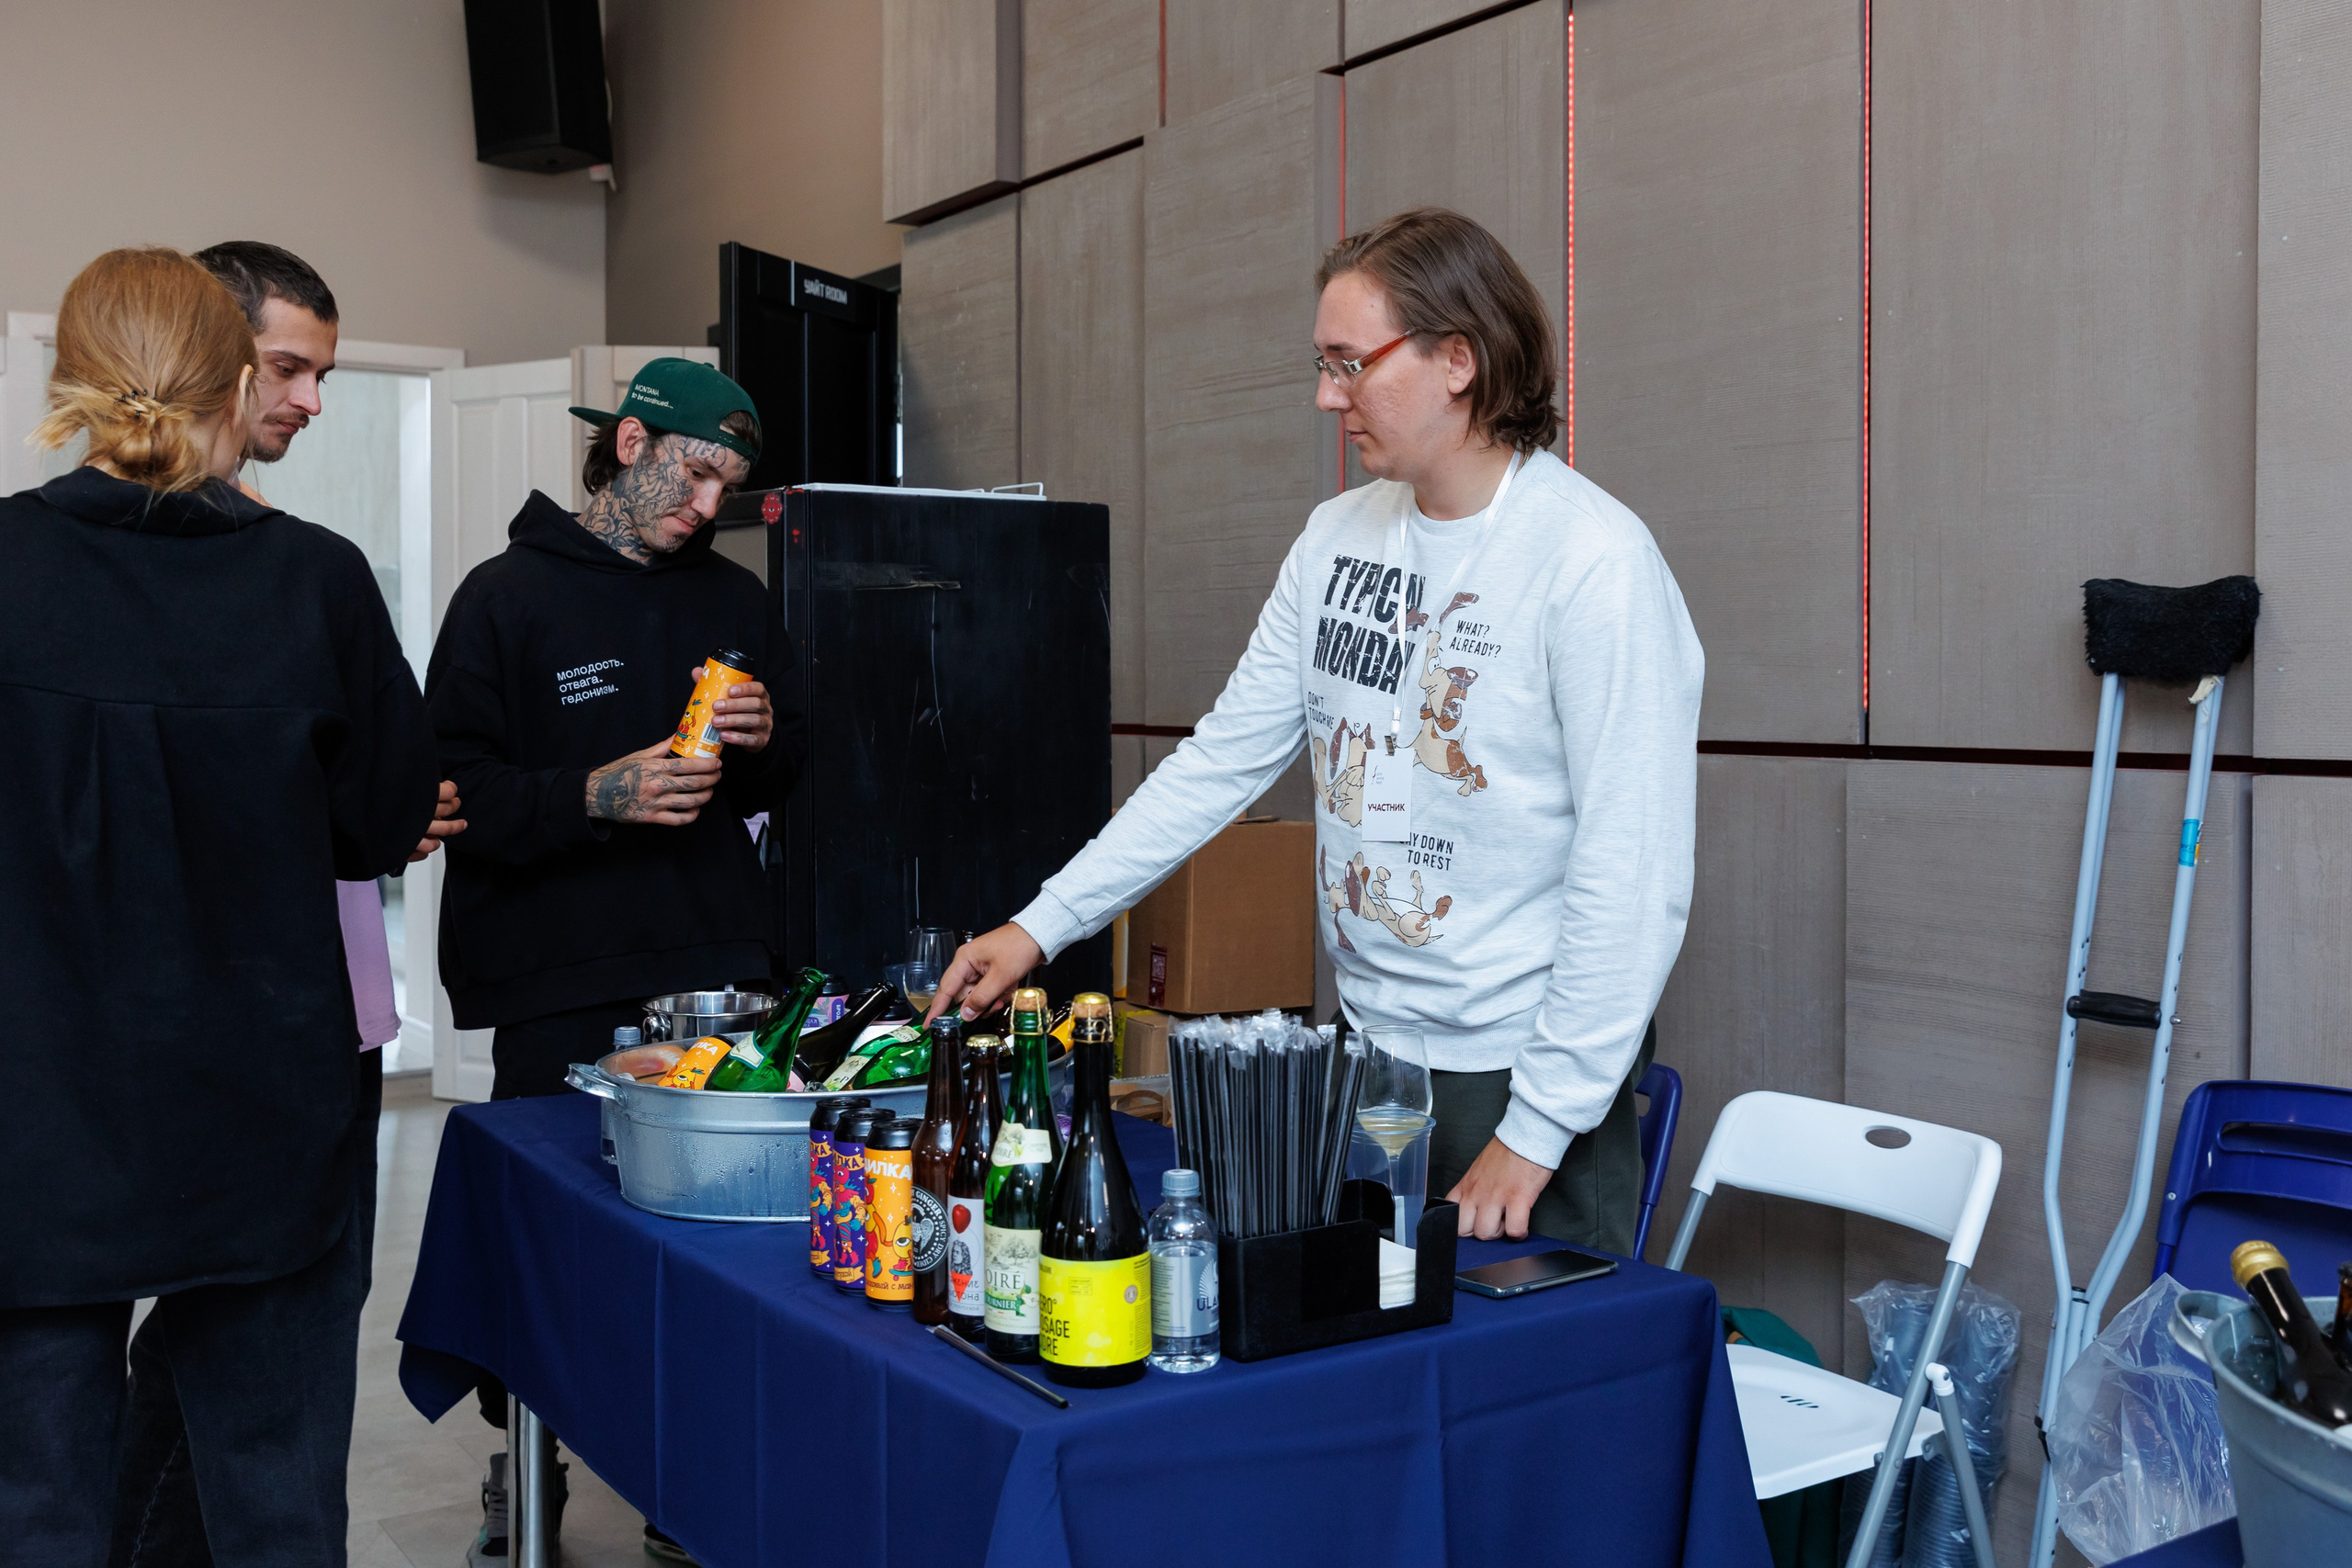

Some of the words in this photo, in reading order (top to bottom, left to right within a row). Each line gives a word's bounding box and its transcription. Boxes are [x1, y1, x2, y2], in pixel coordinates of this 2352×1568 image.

[634, 383, 660, 397] MONTANA
[1456, 620, 1490, 638] WHAT?
[1314, 615, 1416, 695] MONDA
[1449, 637, 1502, 659] ALREADY?
[1367, 803, 1406, 812] УЧАСТНИК
[1420, 835, 1454, 855] DOWN
[1408, 850, 1421, 865] TO
[1422, 852, 1452, 871] REST
[915, 1190, 942, 1217] GINGER
[939, 1220, 947, 1243] SPICY
[933, 1243, 944, 1258] DRY
[985, 1268, 1021, 1290] OIRÉ
[1196, 1295, 1218, 1312] ULA
